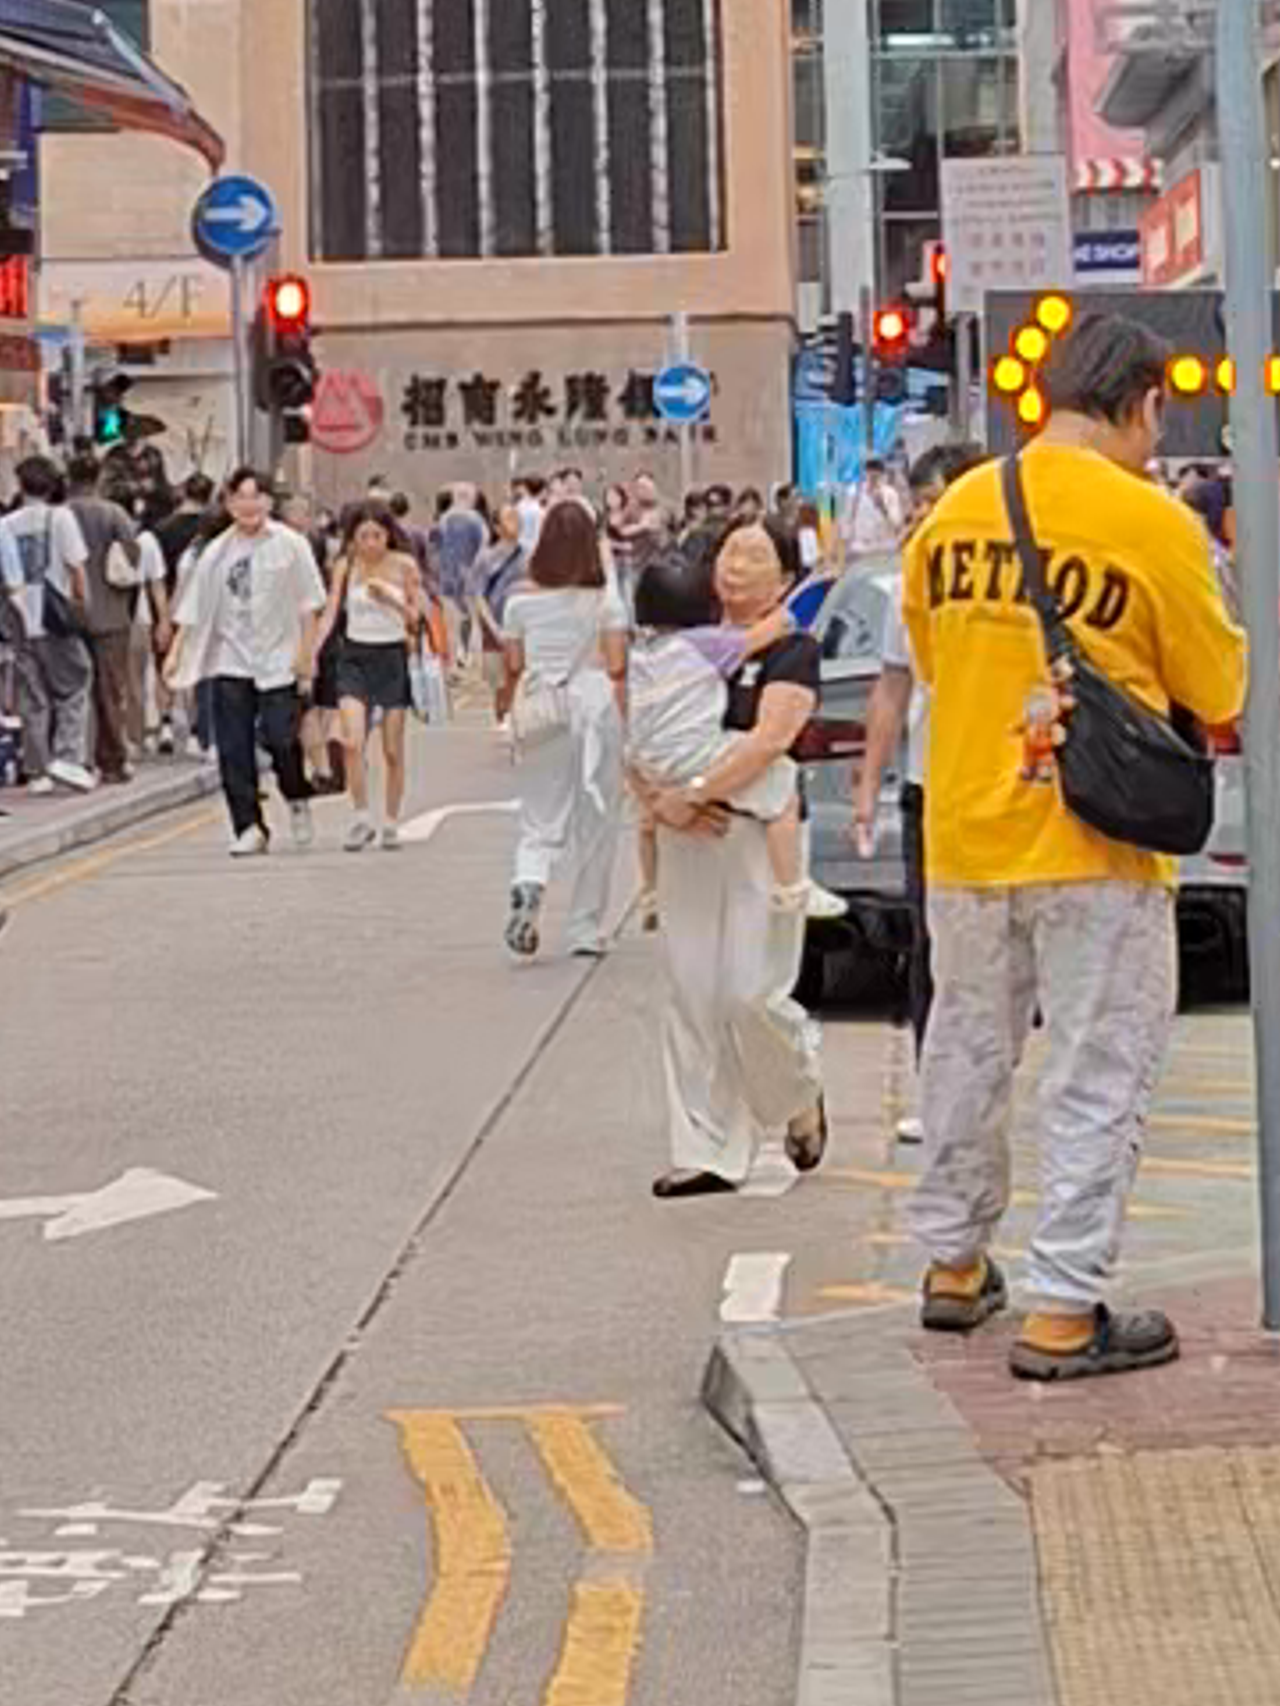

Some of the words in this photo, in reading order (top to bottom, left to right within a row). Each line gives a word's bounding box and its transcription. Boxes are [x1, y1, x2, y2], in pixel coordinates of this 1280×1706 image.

[402, 372, 718, 428] 招商永隆銀
[474, 430, 543, 448] WING
